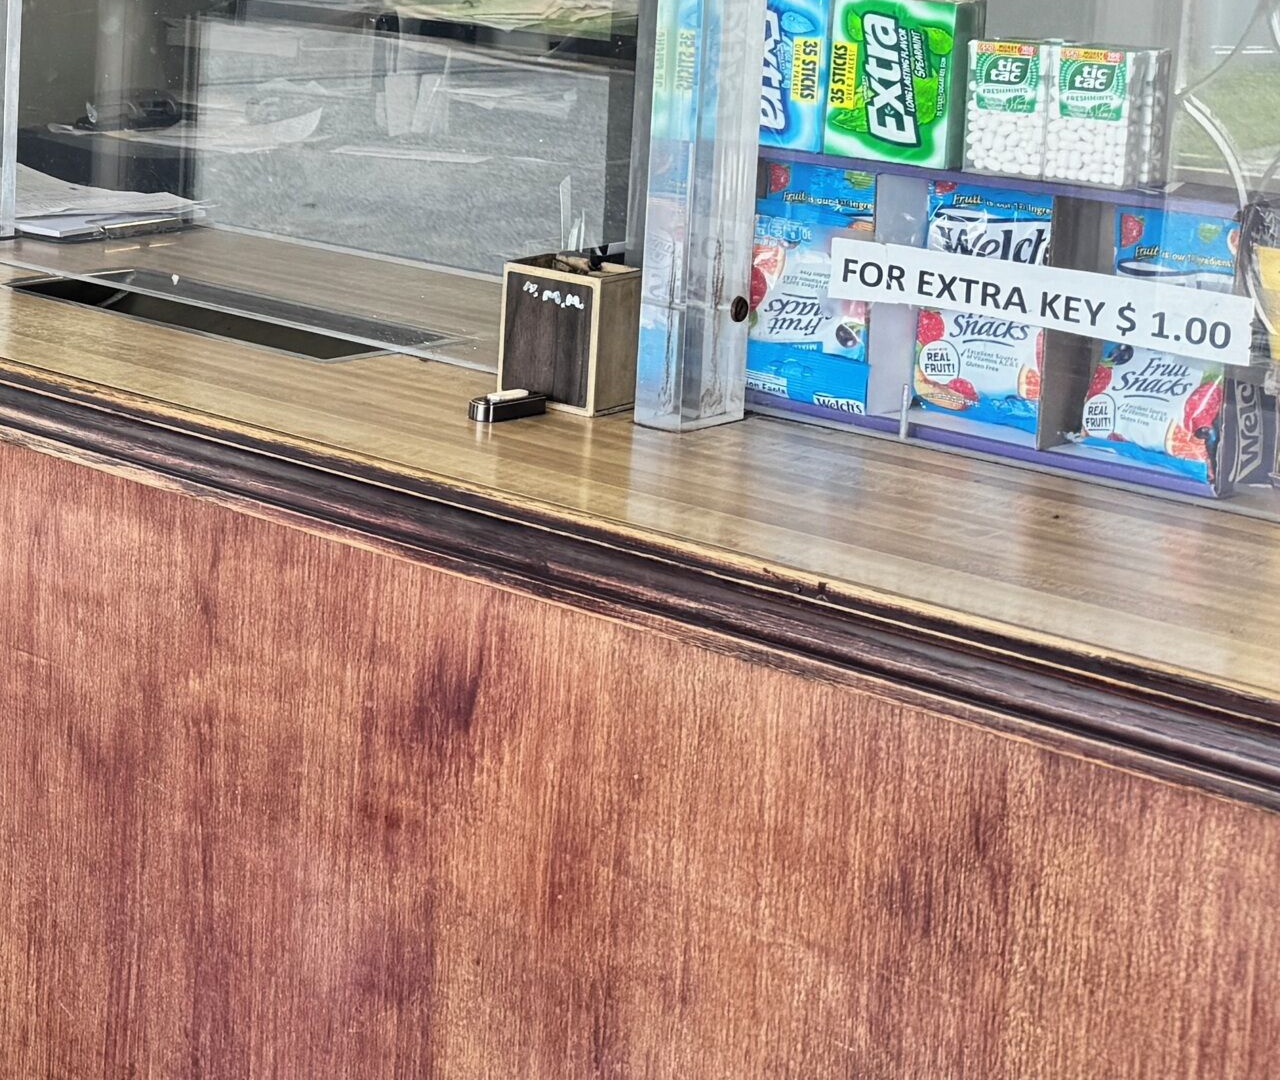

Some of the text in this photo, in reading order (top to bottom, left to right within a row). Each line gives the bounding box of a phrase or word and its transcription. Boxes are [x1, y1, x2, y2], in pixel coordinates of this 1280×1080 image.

[898, 28, 910, 61] FLAVOR
[910, 30, 927, 78] SPEARMINT
[799, 40, 817, 100] 35 STICKS
[998, 58, 1025, 73] tic
[1082, 65, 1112, 80] tic
[830, 44, 848, 104] 35 STICKS
[863, 12, 918, 145] Extra
[990, 68, 1022, 82] tac
[1074, 75, 1107, 89] tac
[952, 193, 984, 205] Fruit
[1135, 246, 1159, 258] Fruit
[841, 257, 906, 293] FOR
[917, 270, 1028, 315] EXTRA
[1040, 291, 1107, 327] KEY
[1111, 302, 1137, 337] $
[1150, 311, 1232, 350] 1.00
[949, 313, 1030, 341] Snacks
[926, 352, 951, 362] REAL
[924, 363, 956, 373] FRUIT!
[1111, 370, 1193, 397] Snacks
[815, 397, 863, 414] Welch's
[1087, 405, 1109, 416] REAL
[1085, 417, 1111, 428] FRUIT!
